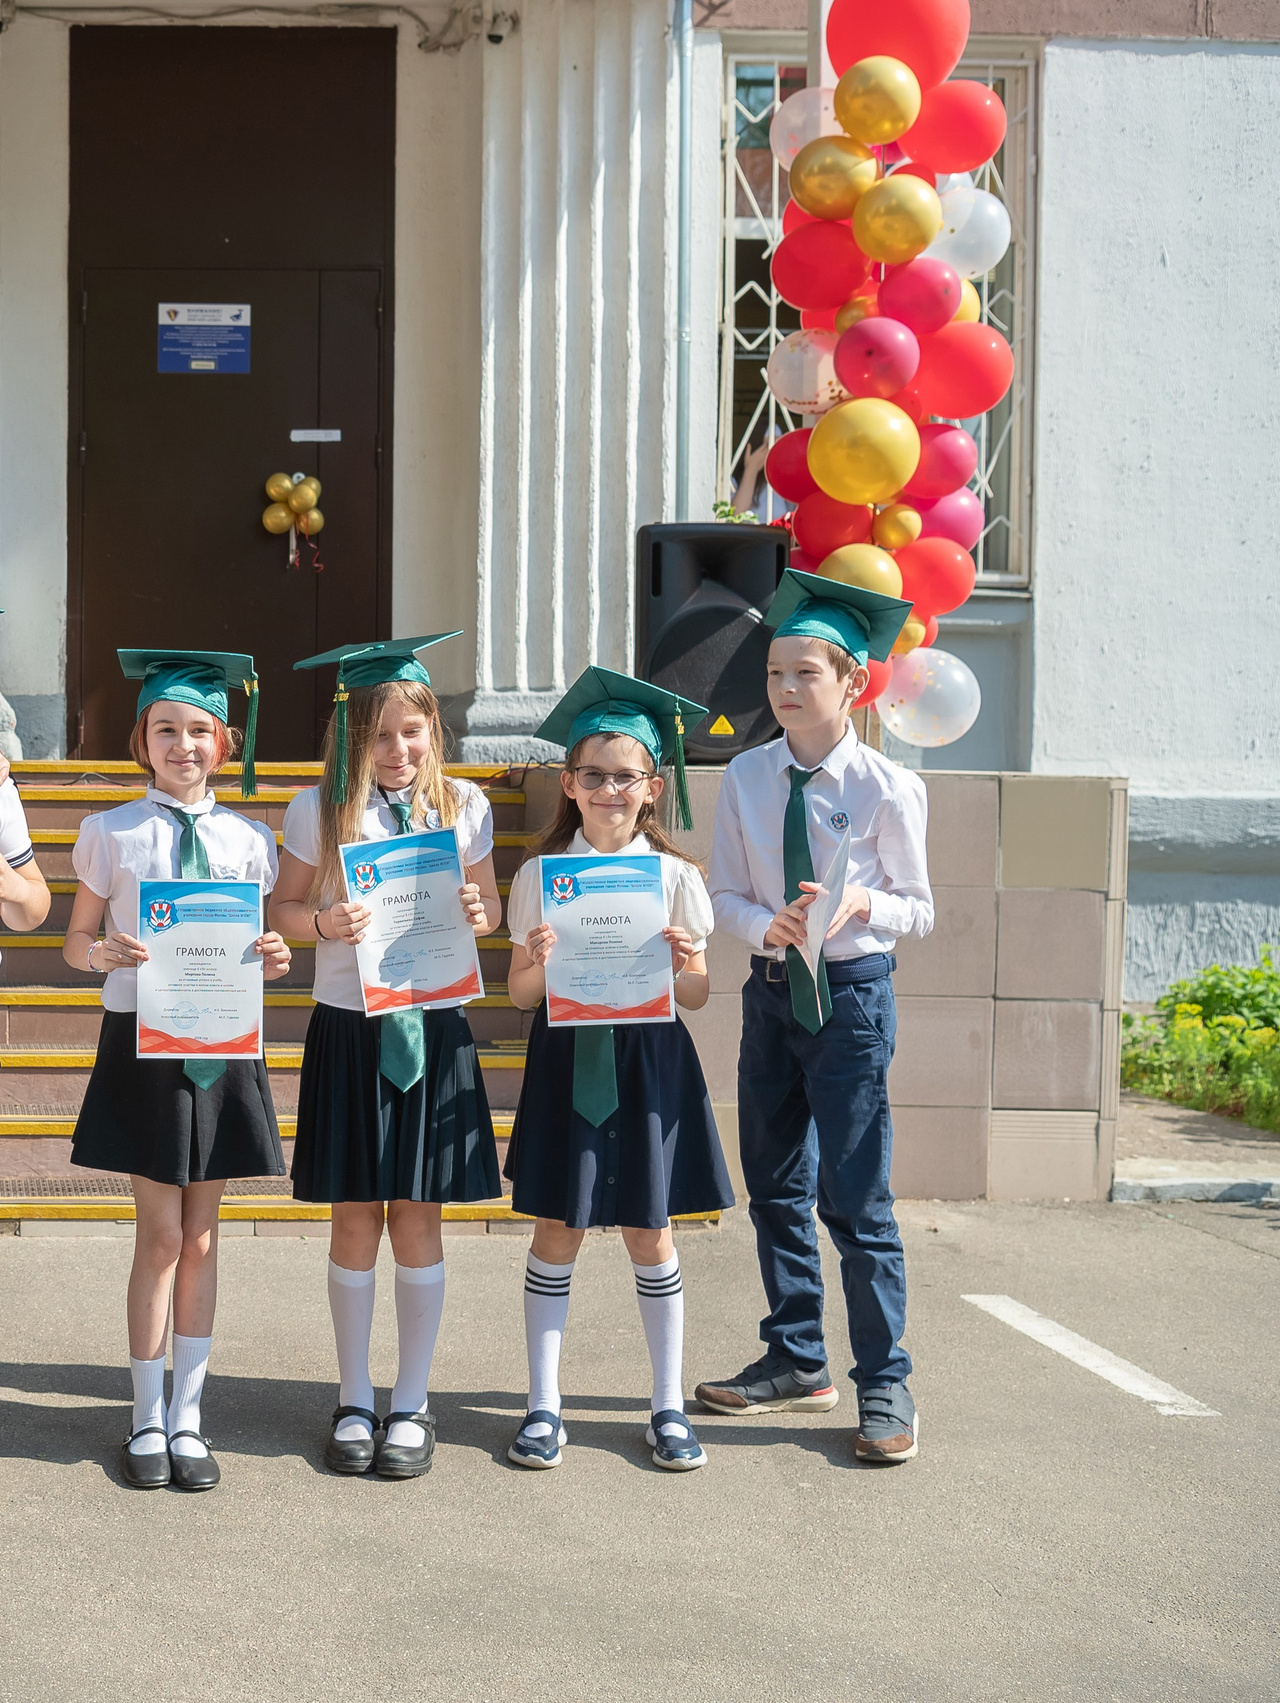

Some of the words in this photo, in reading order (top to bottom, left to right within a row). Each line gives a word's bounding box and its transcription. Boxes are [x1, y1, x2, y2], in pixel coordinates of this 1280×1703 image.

[382, 890, 431, 906] ГРАМОТА
[580, 916, 631, 926] ГРАМОТА
[176, 947, 226, 956] ГРАМОТА
